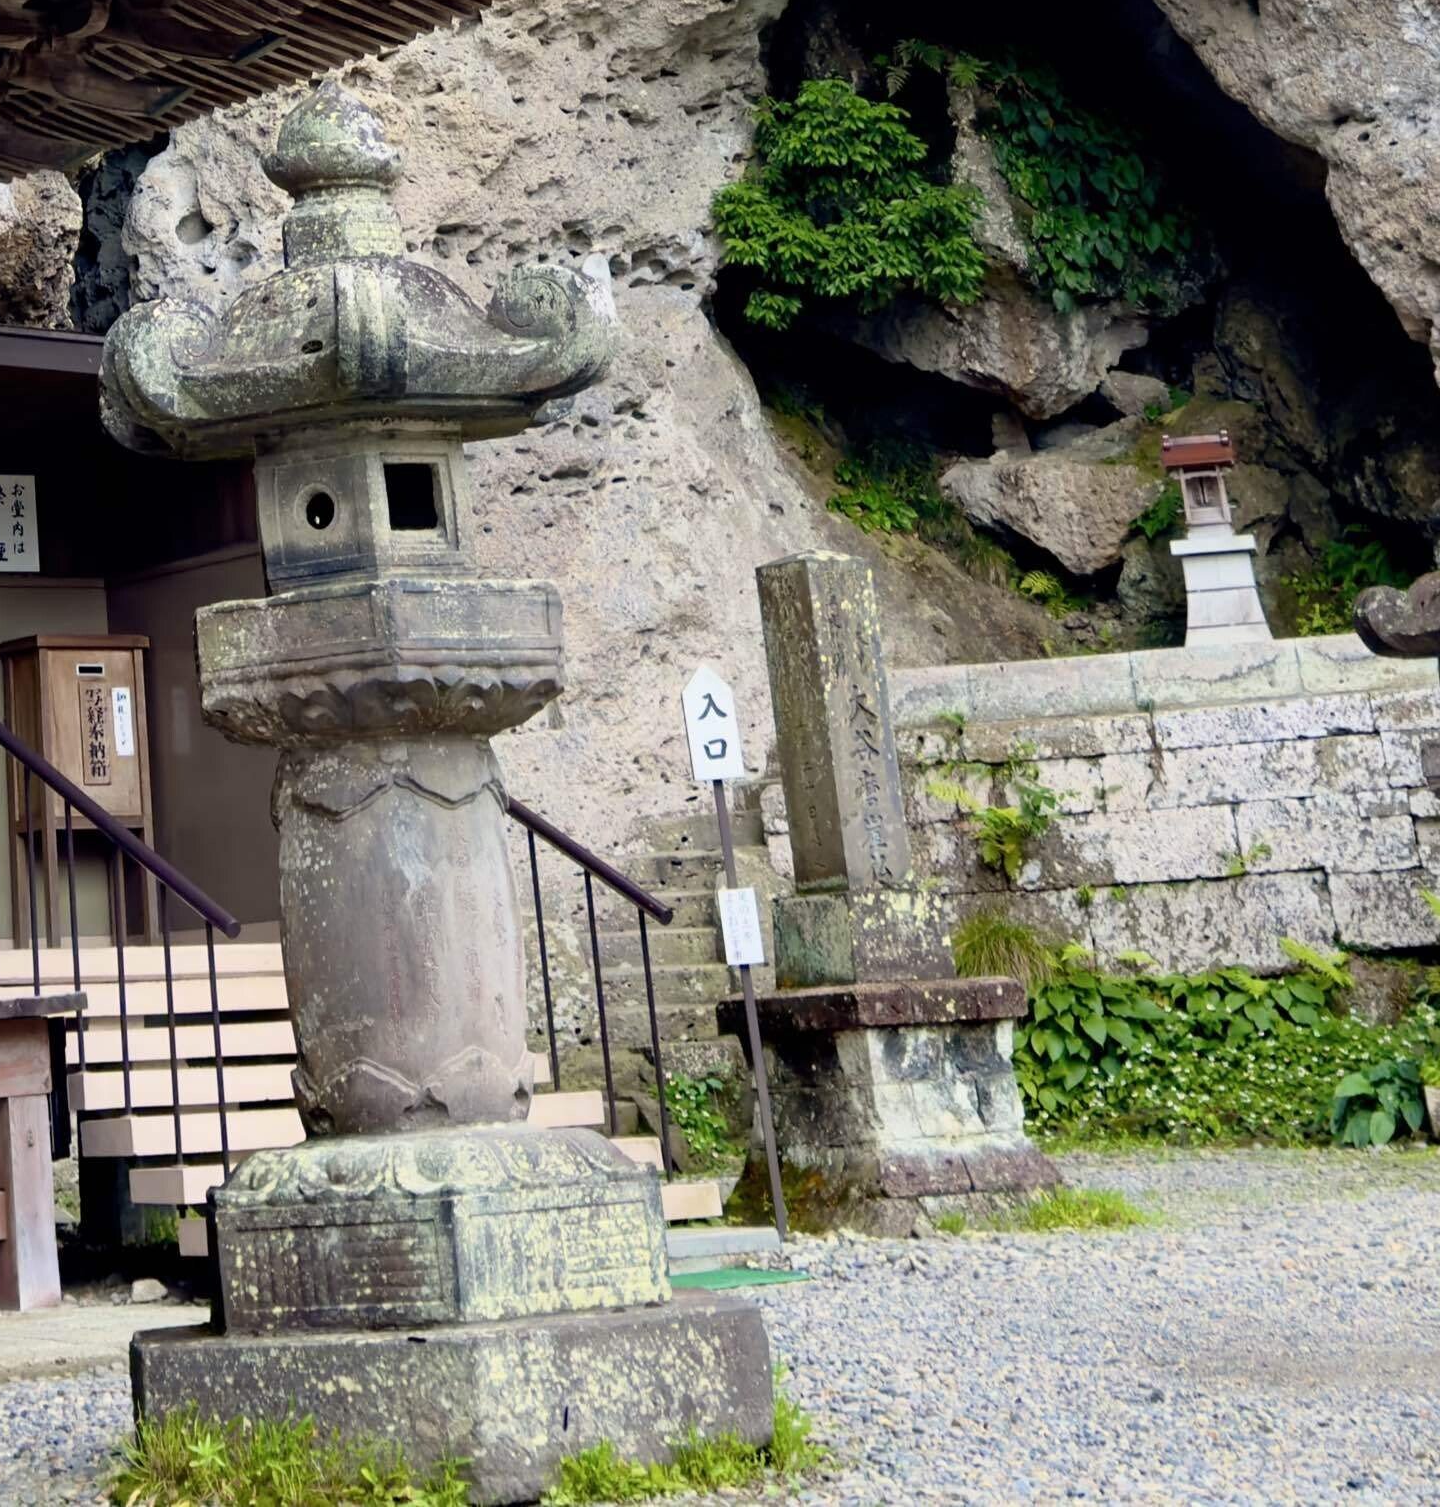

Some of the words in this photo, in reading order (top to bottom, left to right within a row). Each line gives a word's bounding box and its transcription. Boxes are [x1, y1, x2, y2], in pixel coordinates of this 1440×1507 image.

[11, 483, 25, 554] お堂内は
[698, 693, 727, 759] 入口
